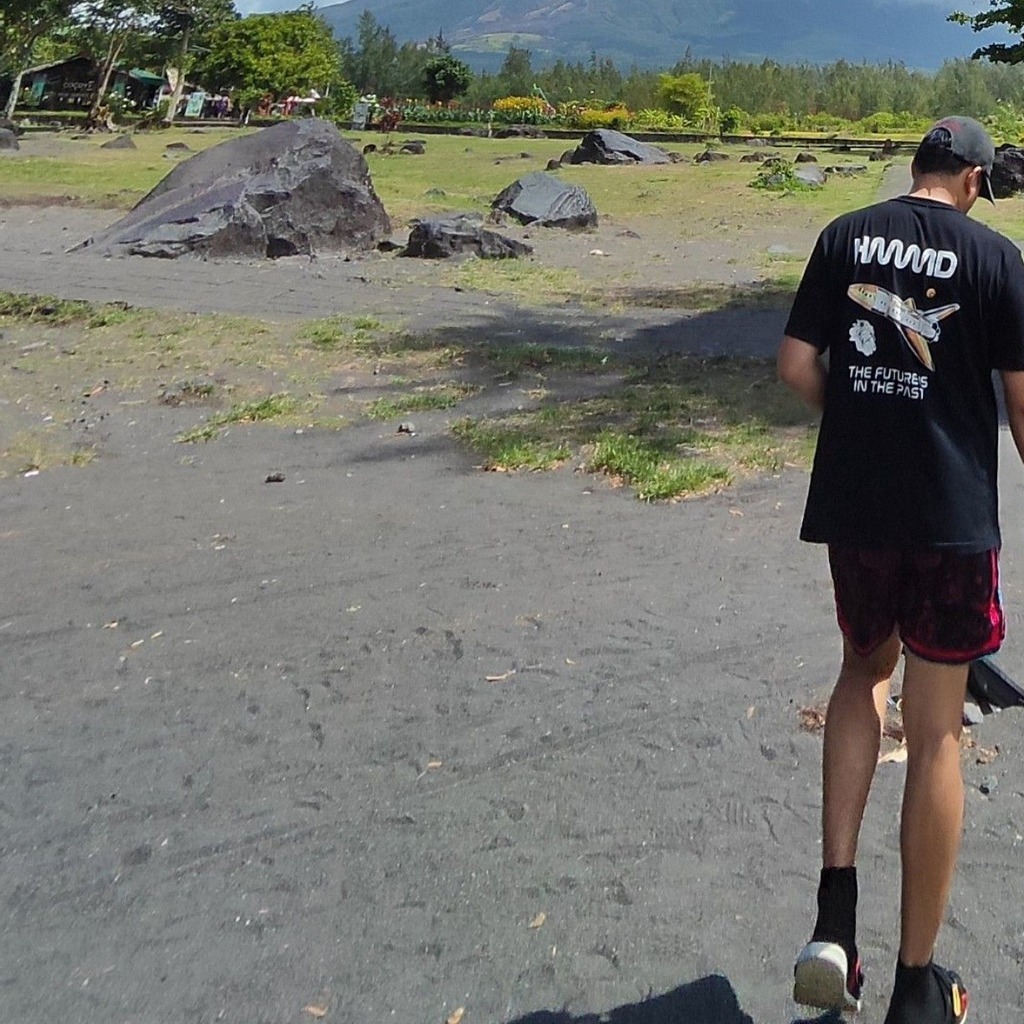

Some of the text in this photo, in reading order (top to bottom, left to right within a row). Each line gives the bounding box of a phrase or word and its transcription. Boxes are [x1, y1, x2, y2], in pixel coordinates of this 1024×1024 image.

[848, 365, 873, 379] THE
[874, 366, 919, 386] FUTURE
[853, 379, 925, 400] IN THE PAST
